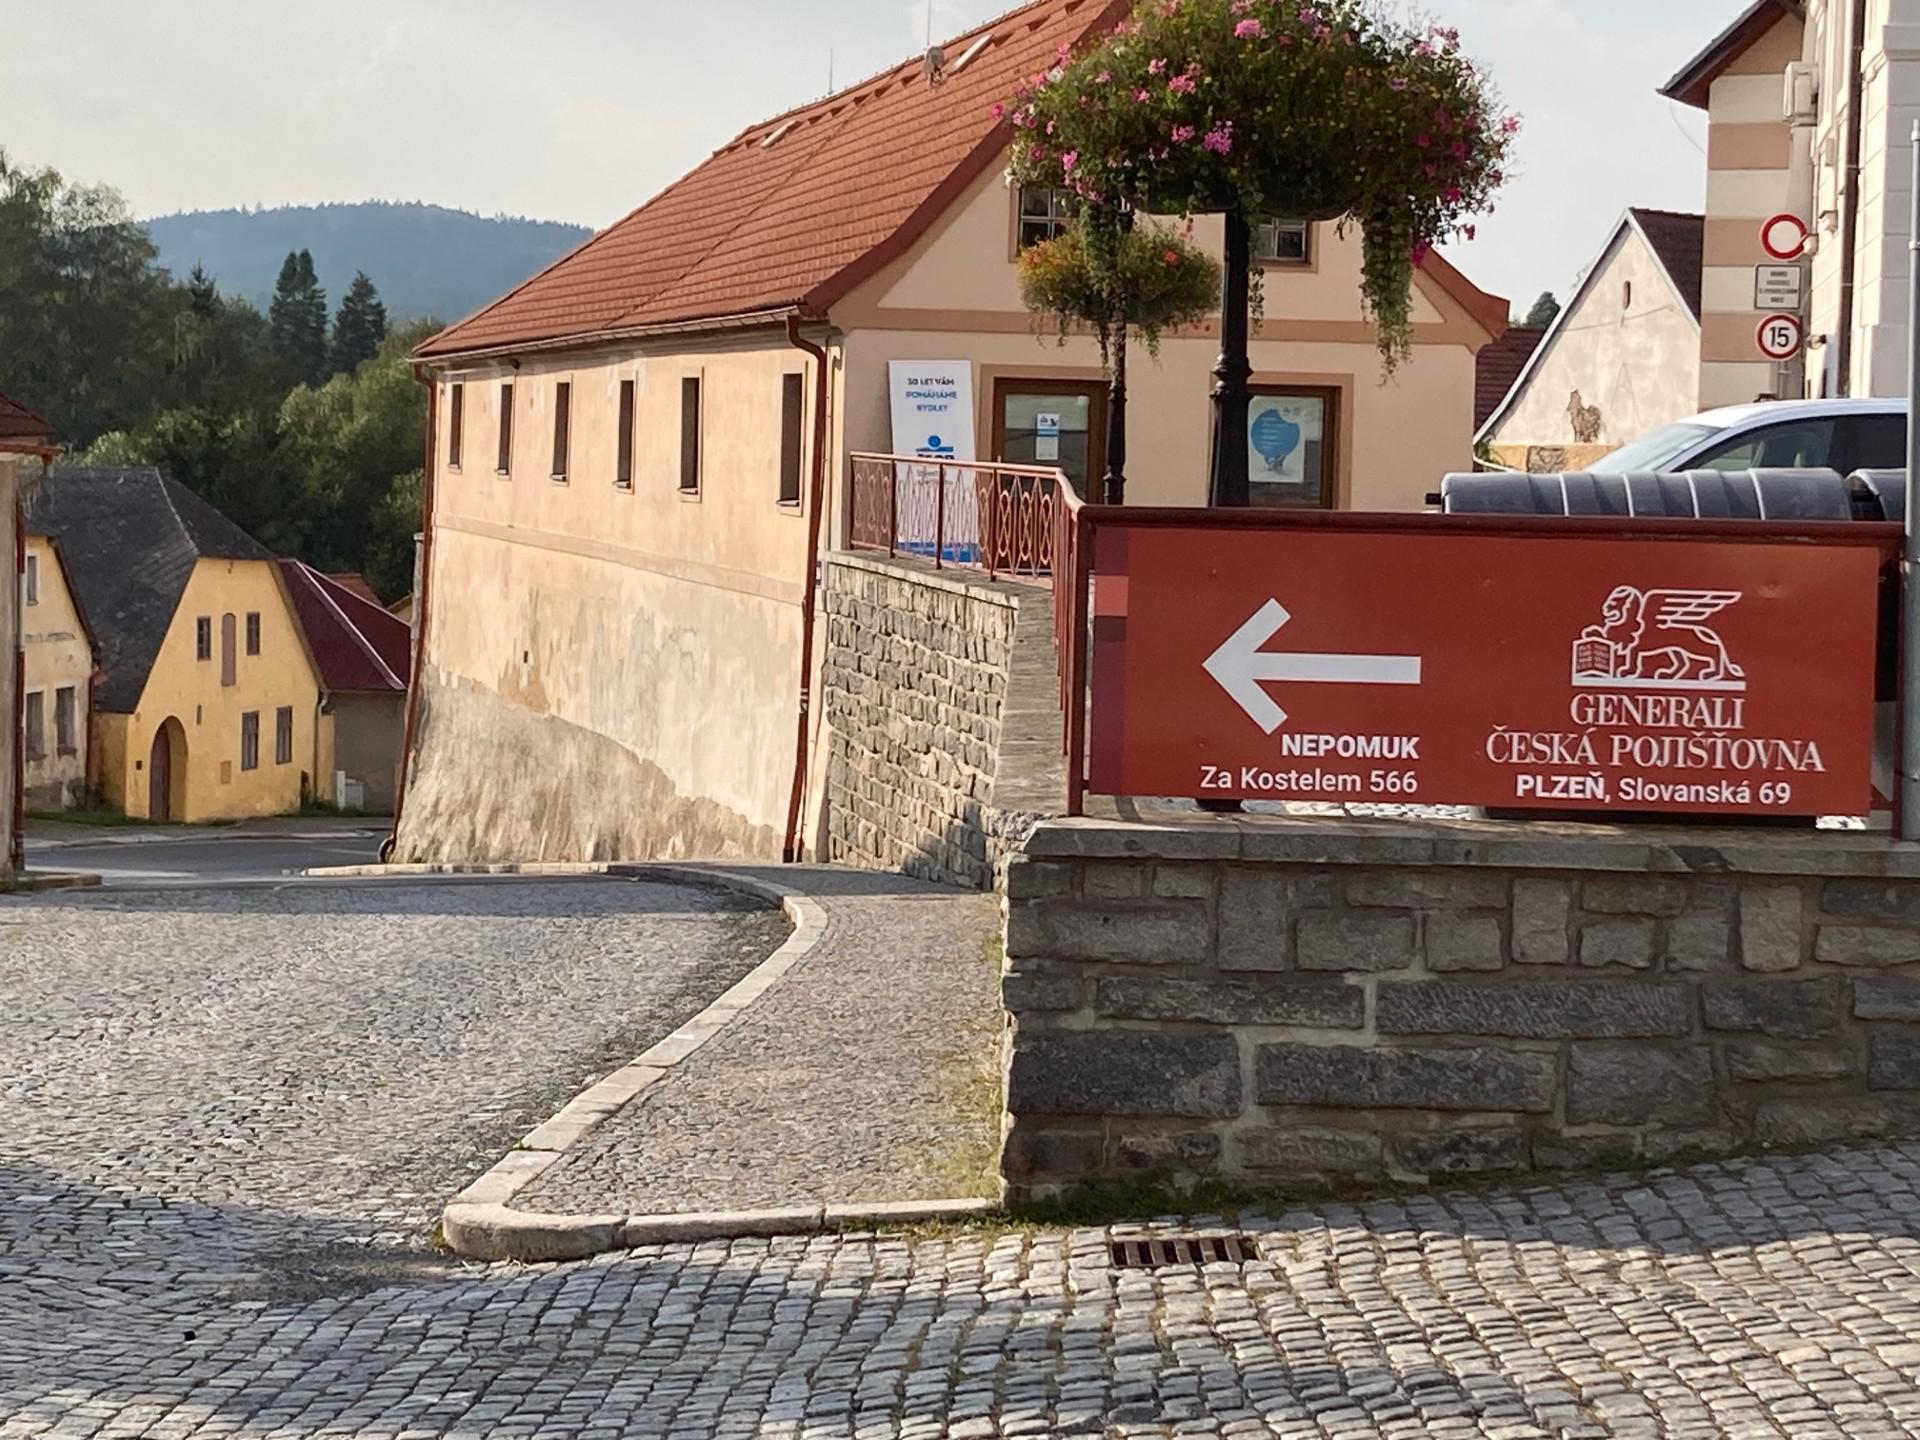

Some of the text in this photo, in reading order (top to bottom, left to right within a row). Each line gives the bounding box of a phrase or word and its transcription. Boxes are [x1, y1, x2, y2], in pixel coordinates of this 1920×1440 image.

[1769, 326, 1790, 348] 15
[1570, 693, 1745, 729] GENERALI
[1281, 734, 1420, 760] NEPOMUK
[1486, 724, 1826, 772] ČESKÁ POJIŠŤOVNA
[1200, 766, 1418, 793] Za Kostelem 566
[1516, 771, 1791, 805] PLZEŇ, Slovanská 69
